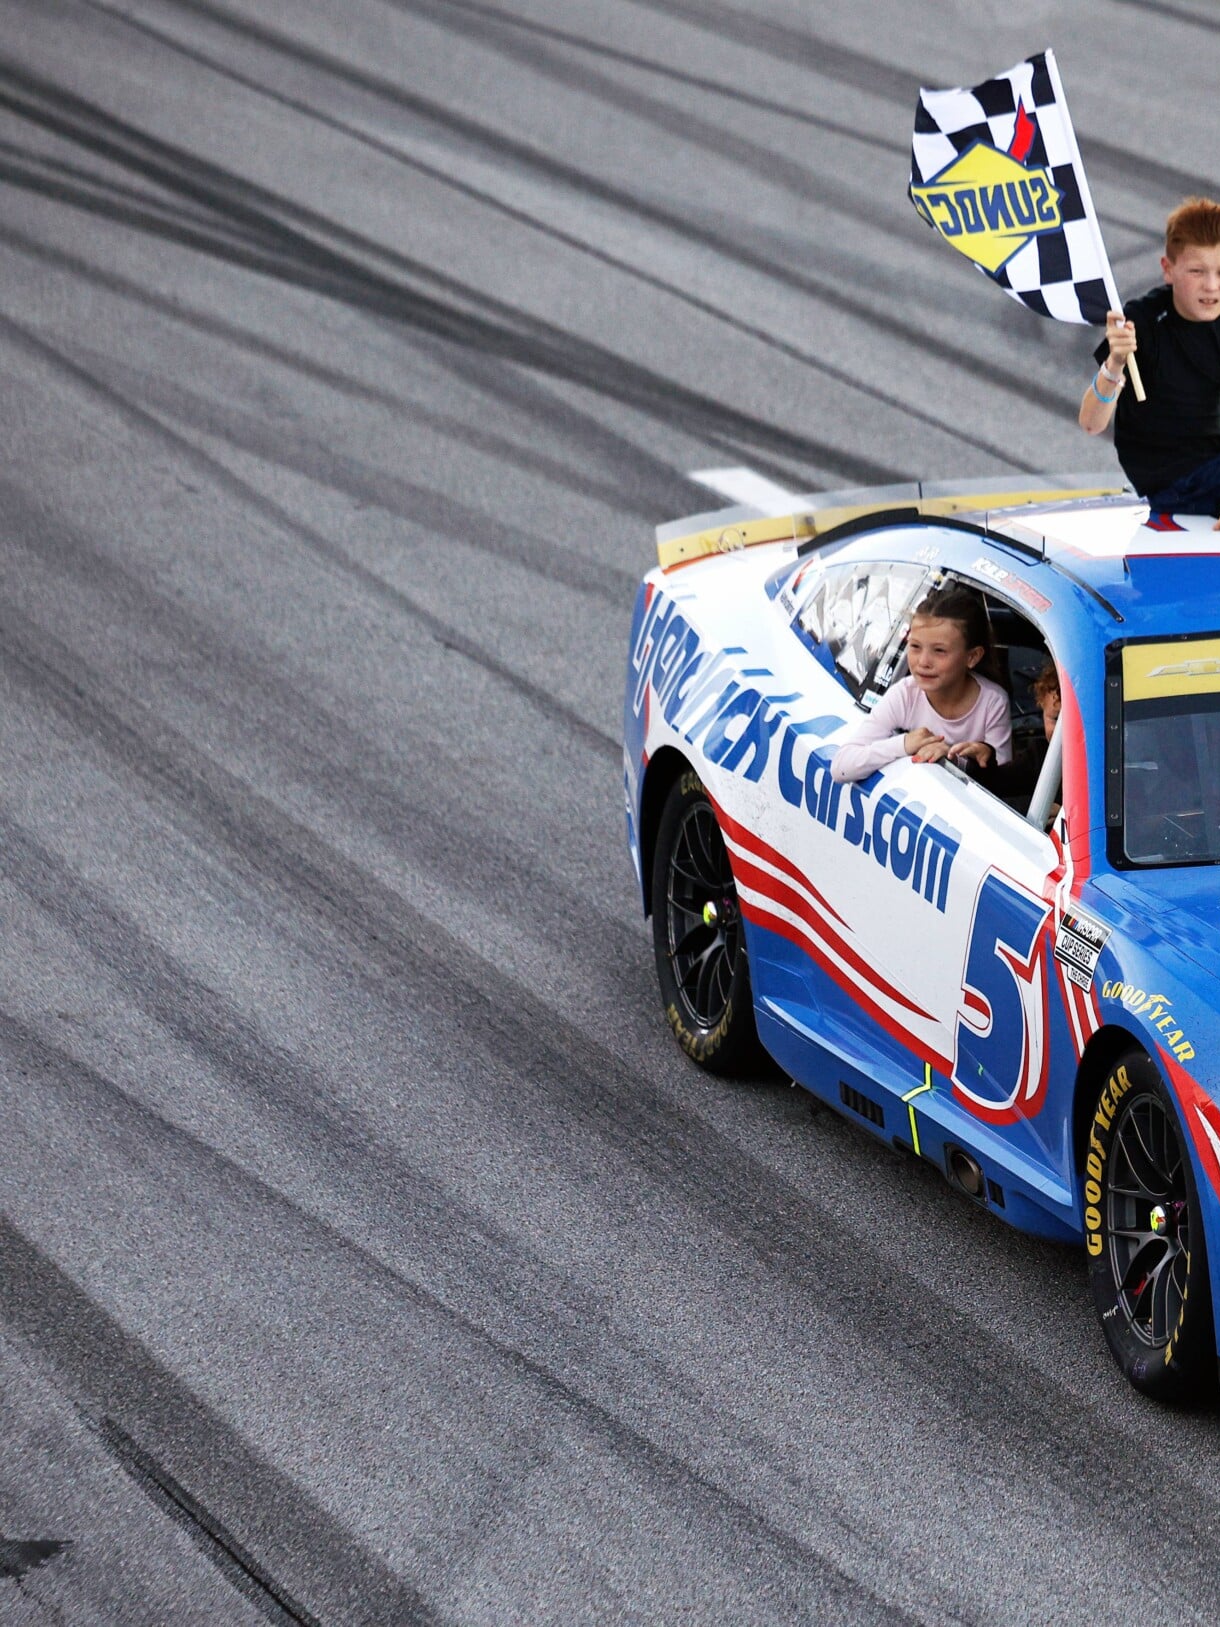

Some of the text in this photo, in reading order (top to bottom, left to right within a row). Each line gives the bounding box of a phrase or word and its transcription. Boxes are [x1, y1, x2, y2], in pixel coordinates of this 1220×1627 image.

[1061, 935, 1093, 965] CUP SERIES
[1075, 917, 1103, 944] NASCAR
[951, 866, 1053, 1112] 5
[1102, 980, 1196, 1063] GOODYEAR
[1085, 1065, 1132, 1256] GOODYEAR
